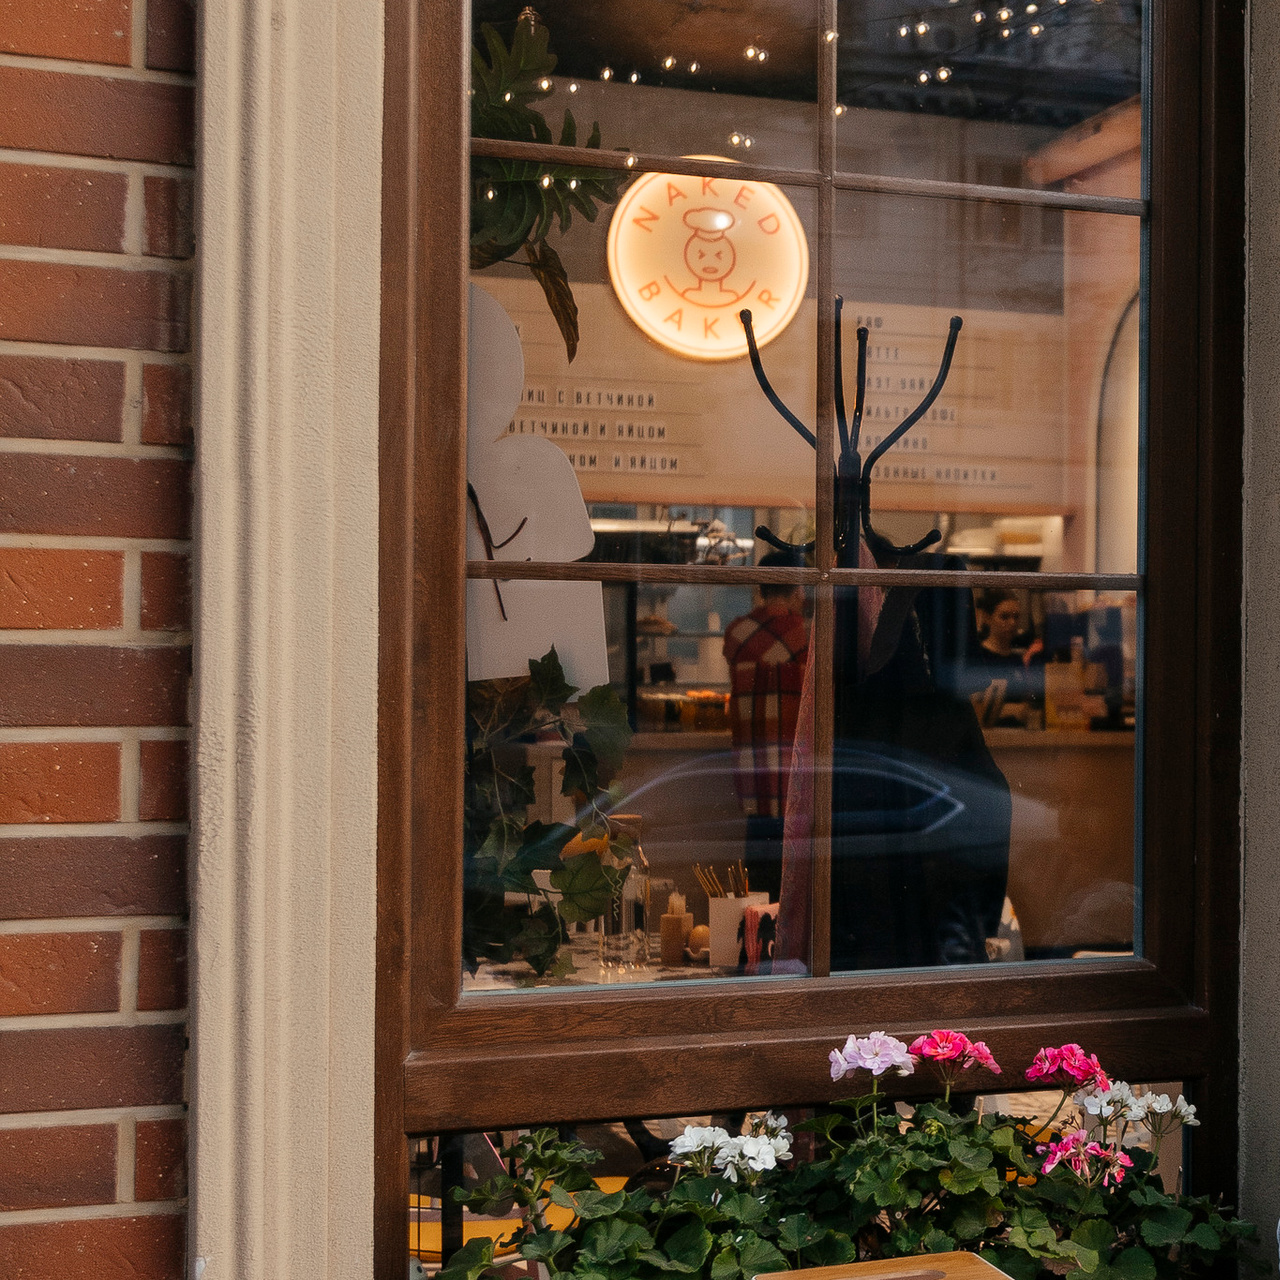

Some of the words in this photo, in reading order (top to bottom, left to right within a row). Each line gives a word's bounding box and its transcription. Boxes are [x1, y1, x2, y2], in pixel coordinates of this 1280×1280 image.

[632, 176, 781, 235] NAKED
[638, 280, 781, 340] BAKR
[866, 345, 899, 359] АТТЕ
[557, 390, 565, 404] С
[576, 391, 655, 407] ВЕТЧИНОЙ
[599, 424, 606, 436] И
[617, 424, 666, 439] ЯЙЦОМ
[614, 455, 621, 468] И
[630, 455, 678, 470] ЯЙЦОМ
